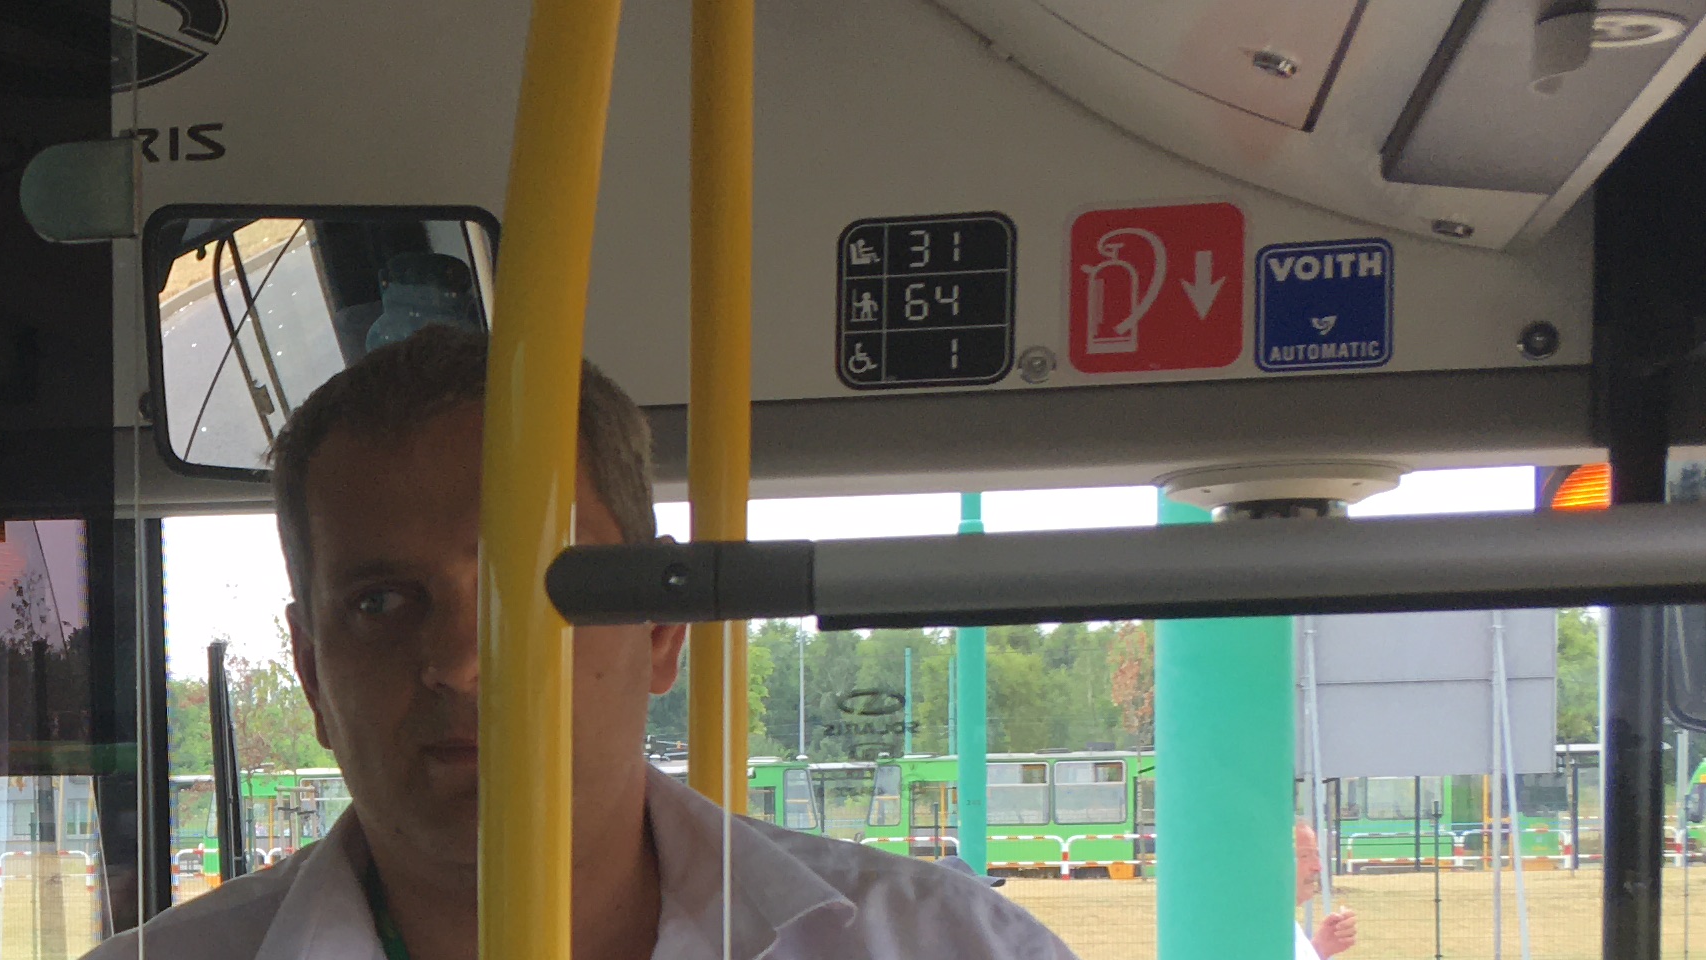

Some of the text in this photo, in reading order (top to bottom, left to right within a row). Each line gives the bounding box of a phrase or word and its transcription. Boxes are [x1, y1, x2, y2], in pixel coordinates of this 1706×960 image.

[907, 230, 962, 268] 31
[1268, 251, 1383, 282] VOITH
[904, 282, 962, 322] 64
[949, 337, 960, 369] 1
[1269, 340, 1381, 362] AUTOMATIC
